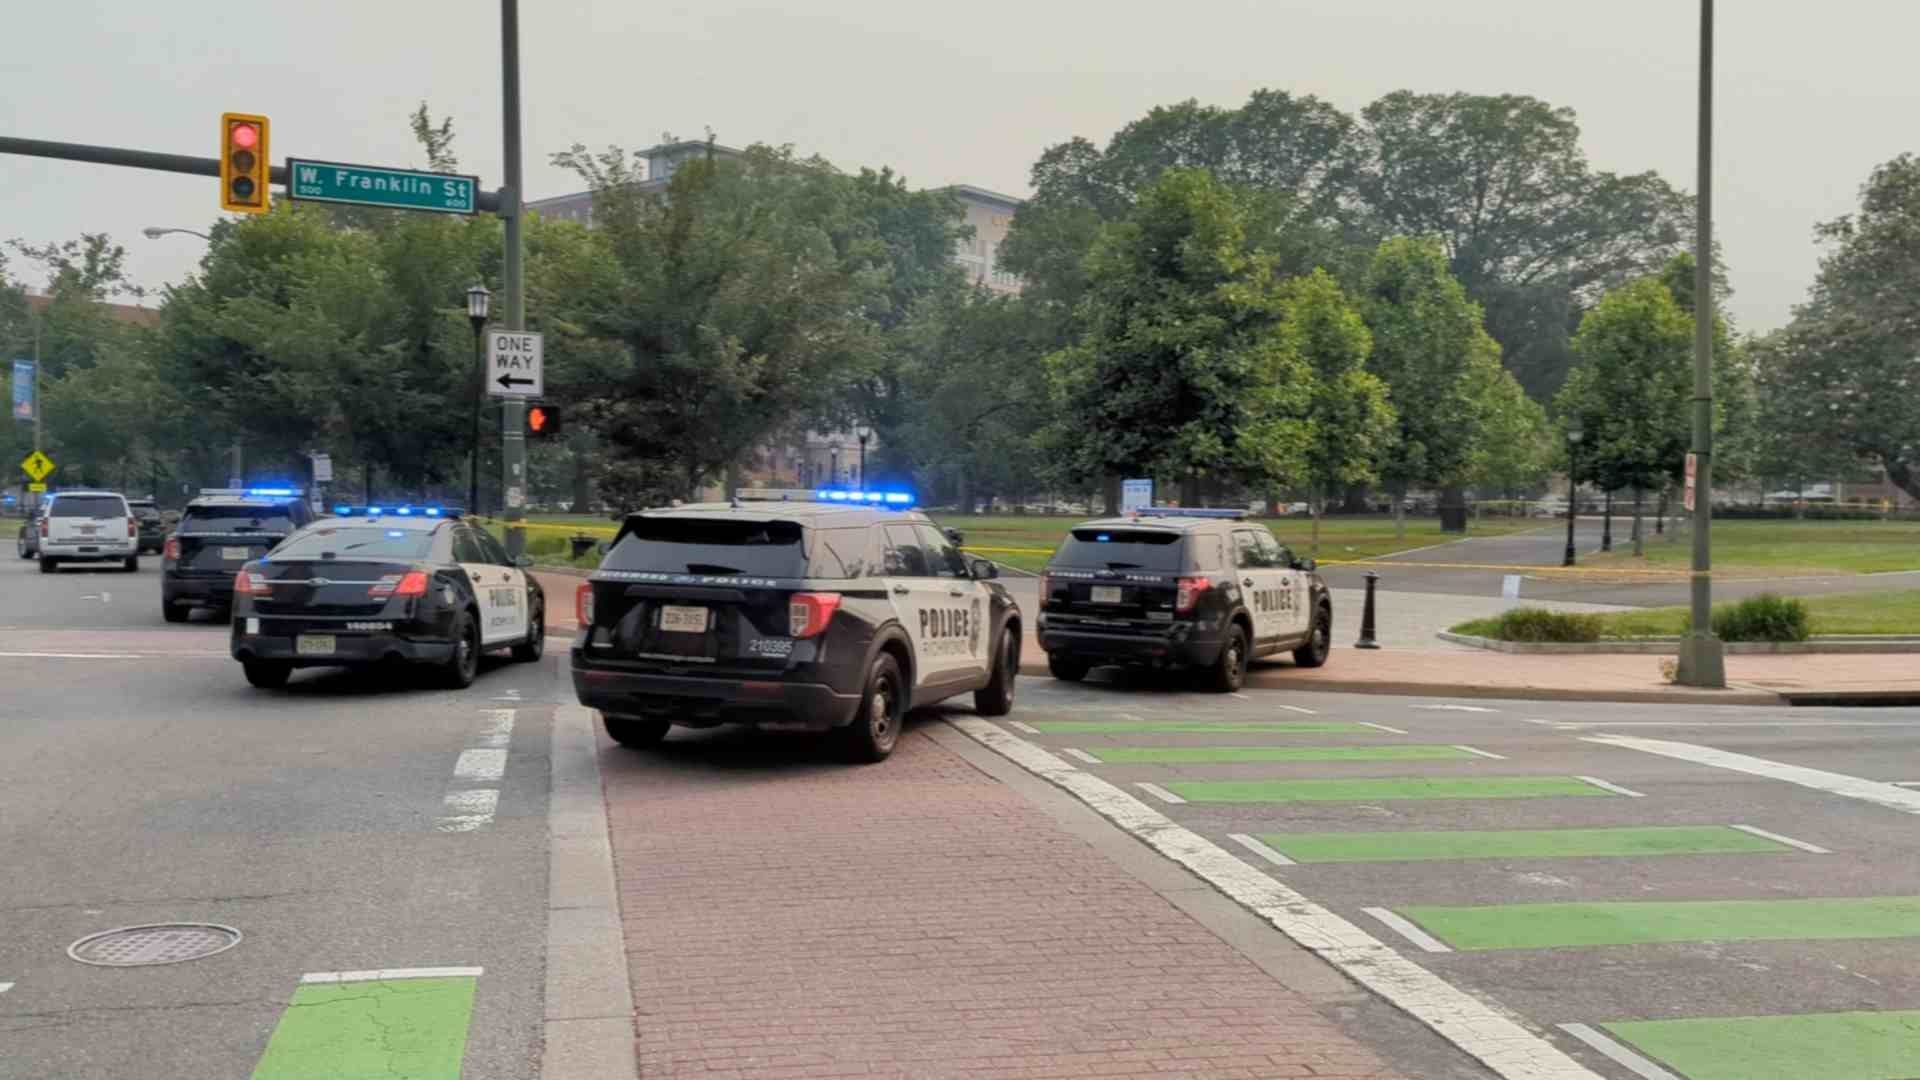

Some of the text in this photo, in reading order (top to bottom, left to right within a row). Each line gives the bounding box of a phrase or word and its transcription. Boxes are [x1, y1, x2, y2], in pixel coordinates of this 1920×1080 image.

[299, 166, 467, 198] W. Franklin St
[496, 336, 533, 352] ONE
[496, 355, 534, 369] WAY
[1253, 589, 1293, 612] POLICE
[918, 608, 969, 638] POLICE
